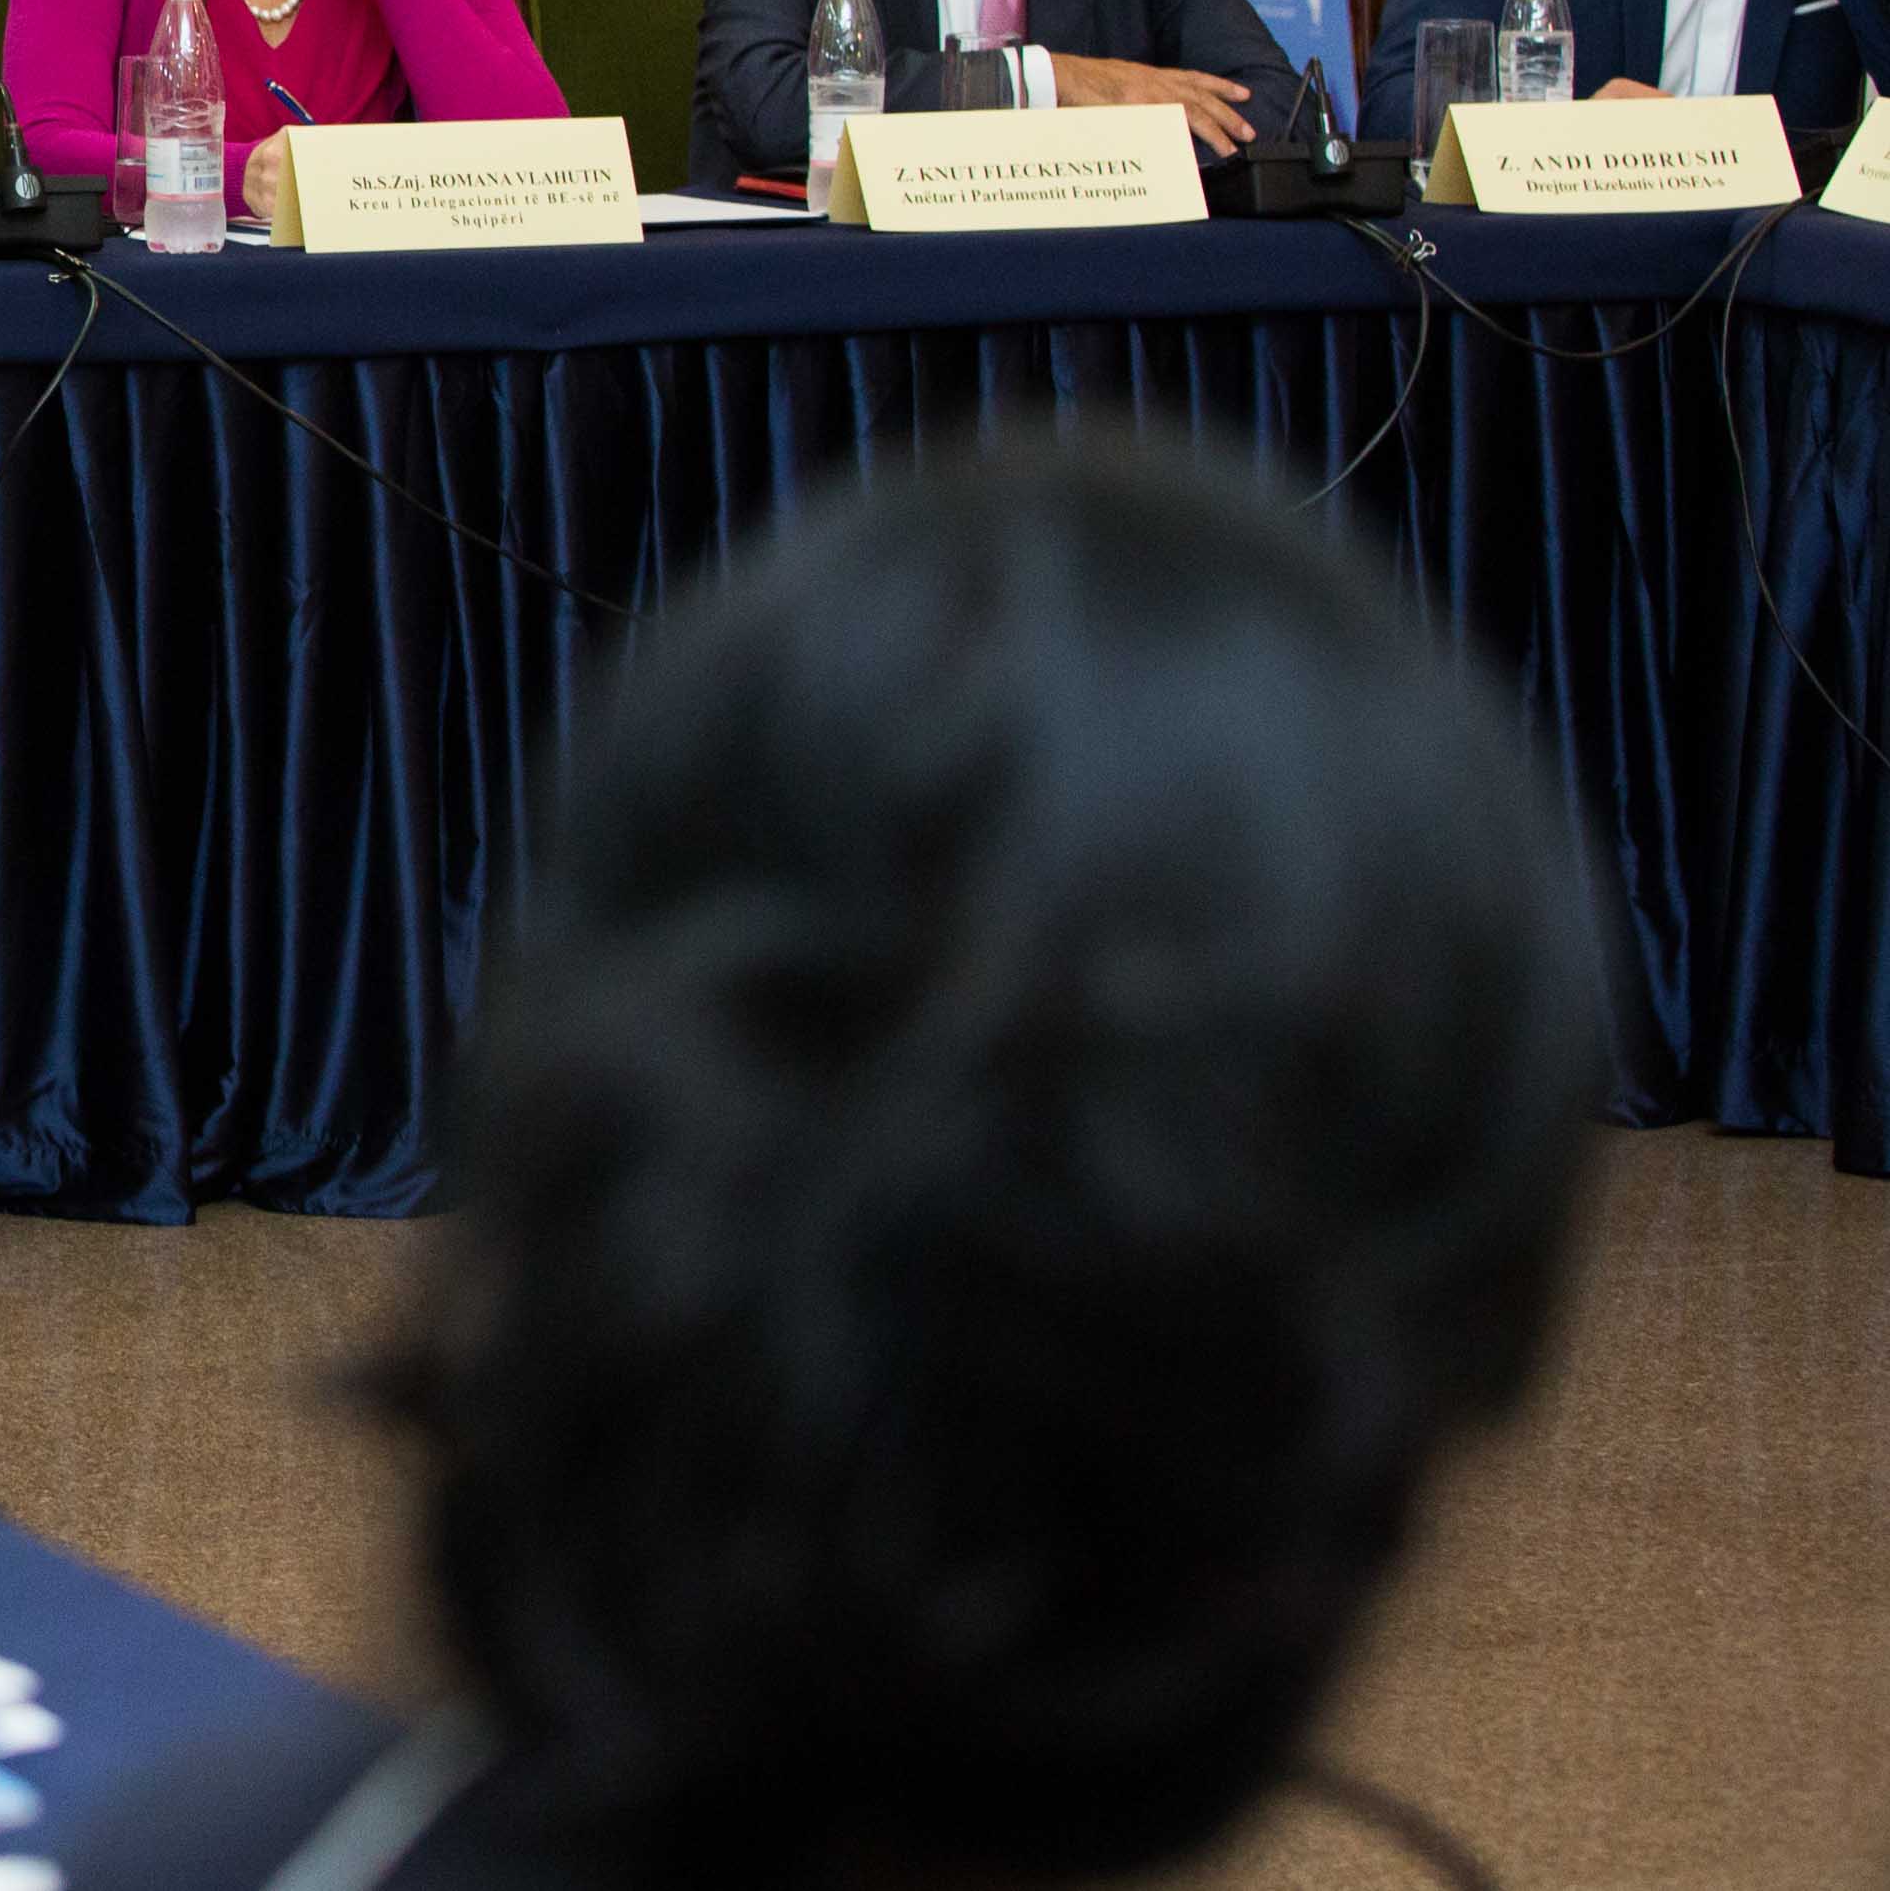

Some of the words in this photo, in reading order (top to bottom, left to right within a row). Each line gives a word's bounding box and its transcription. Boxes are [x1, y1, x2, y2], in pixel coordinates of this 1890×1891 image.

[920, 165, 979, 181] KNUT
[983, 159, 1143, 180] FLECKENSTEIN
[1498, 156, 1520, 171] Z.
[1531, 154, 1593, 170] ANDI
[1604, 149, 1739, 169] DOBRUSHI
[430, 172, 512, 189] ROMANA
[517, 168, 612, 186] VLAHUTIN
[349, 198, 389, 211] Kreu
[411, 194, 516, 211] Delegacionit
[903, 189, 955, 204] Anëtar
[971, 186, 1067, 202] Parlamentit
[1072, 184, 1147, 202] Europian
[451, 212, 524, 229] Shqipëri
